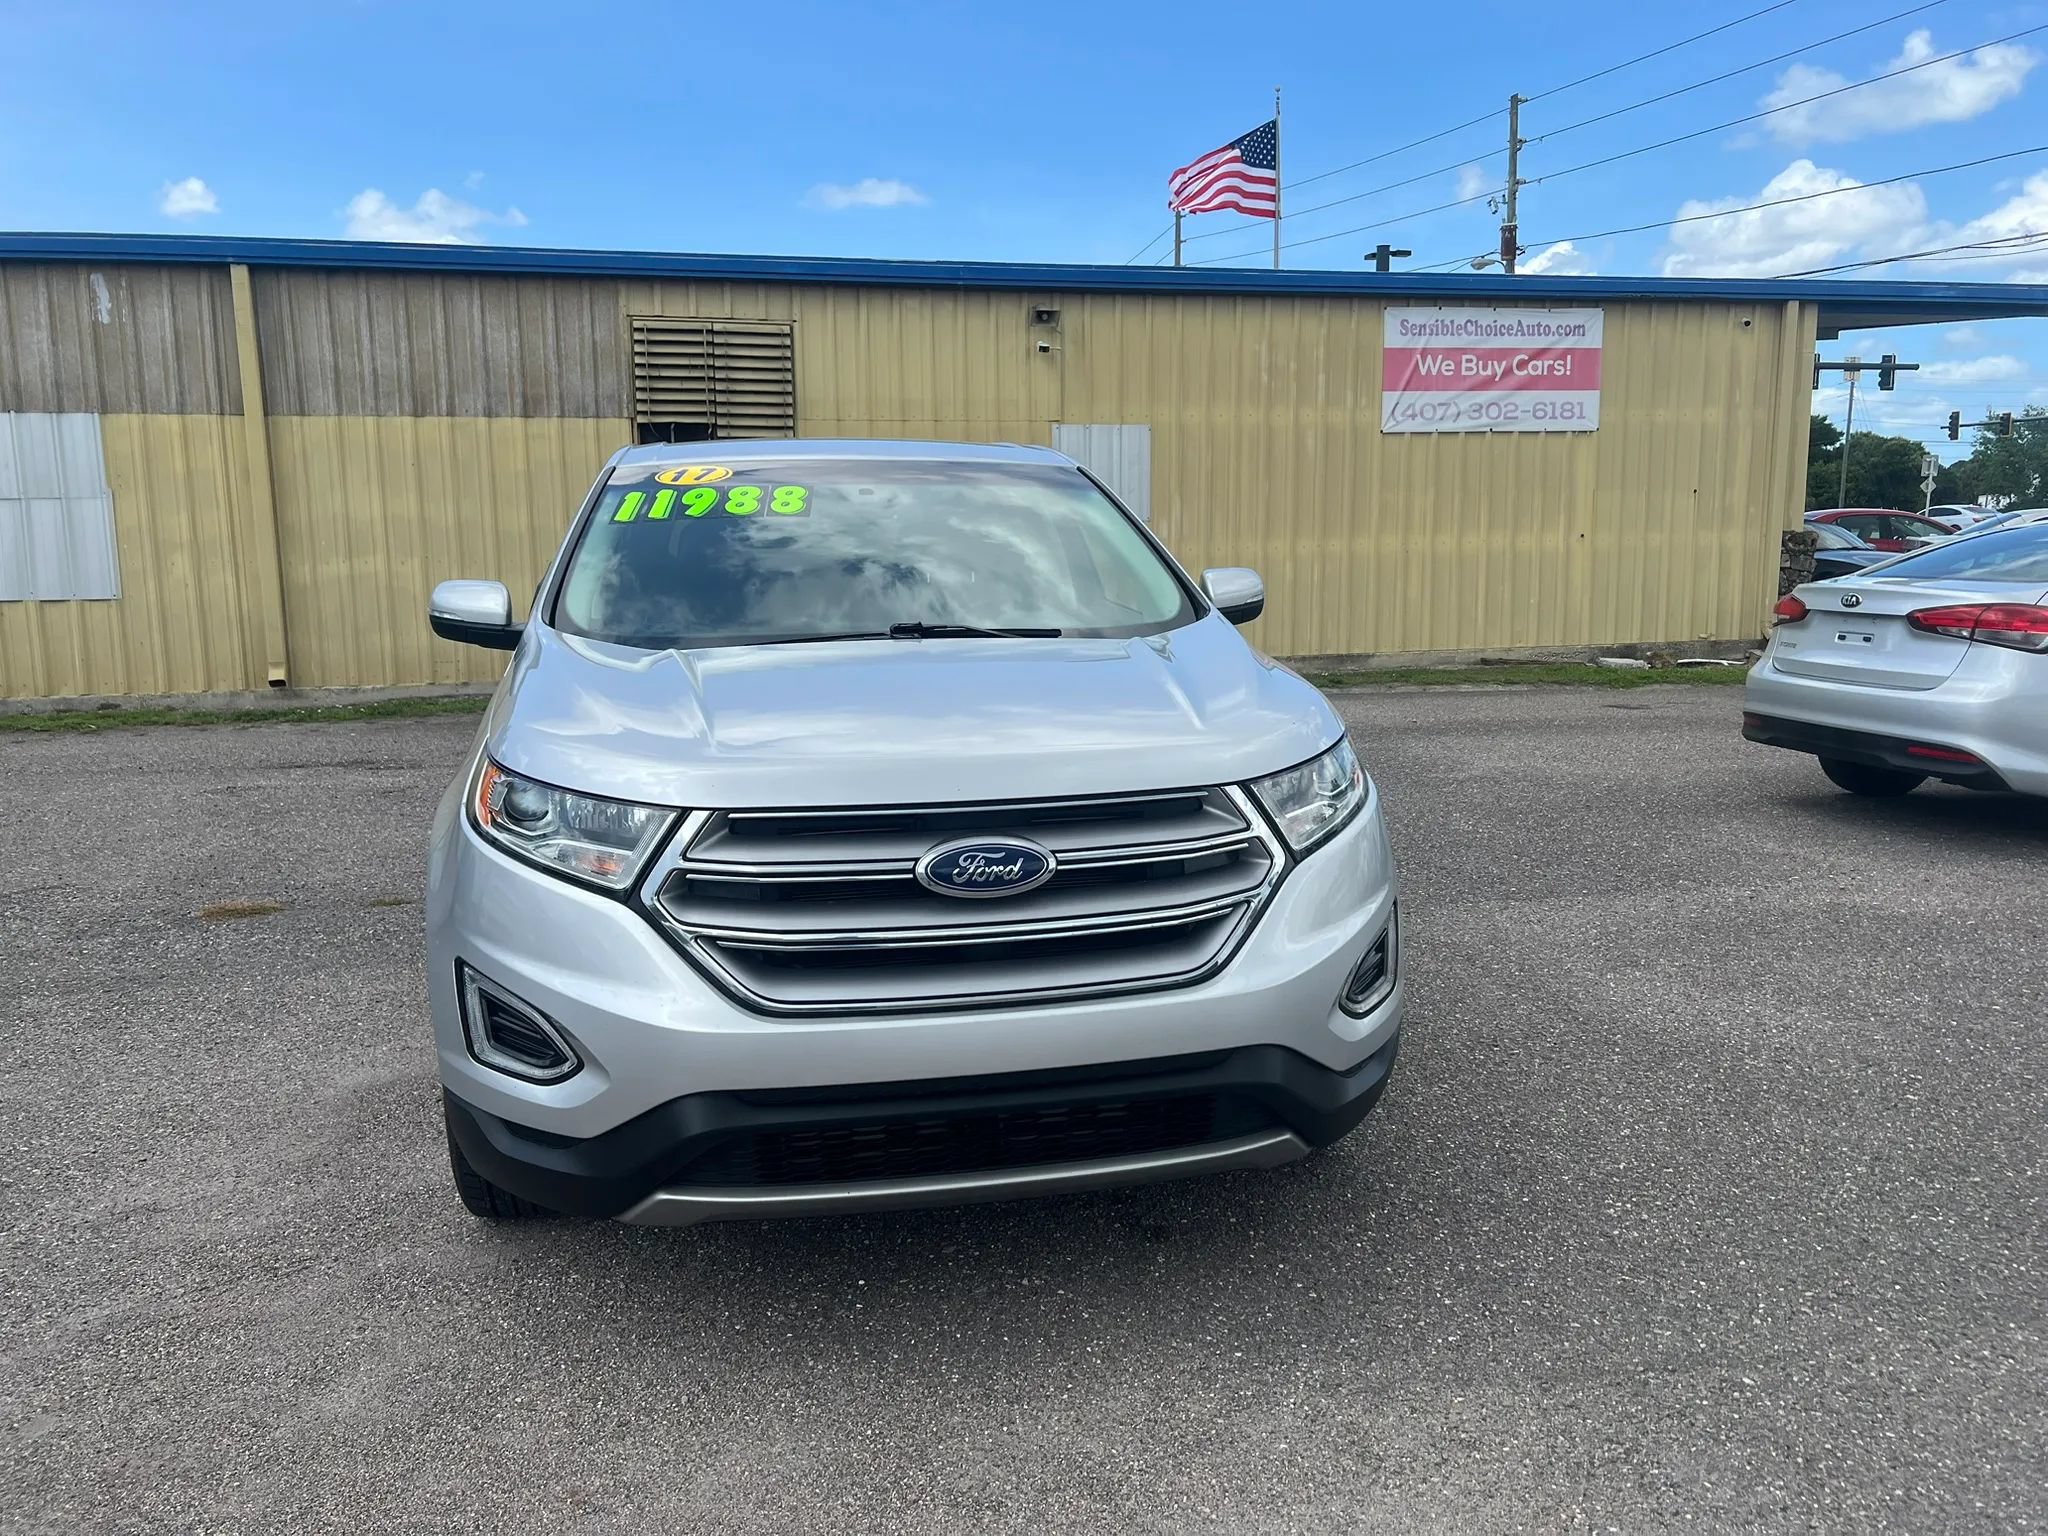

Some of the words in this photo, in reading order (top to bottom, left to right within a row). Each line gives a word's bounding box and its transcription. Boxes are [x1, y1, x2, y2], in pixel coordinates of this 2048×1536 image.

[1399, 318, 1586, 337] SensibleChoiceAuto.com
[1416, 354, 1456, 376] We
[1461, 354, 1507, 381] Buy
[1512, 354, 1572, 376] Cars!
[1391, 401, 1461, 423] (407)
[1467, 401, 1586, 421] 302-6181
[670, 467, 718, 482] 17
[613, 485, 809, 523] 11988
[952, 851, 1024, 884] Ford
